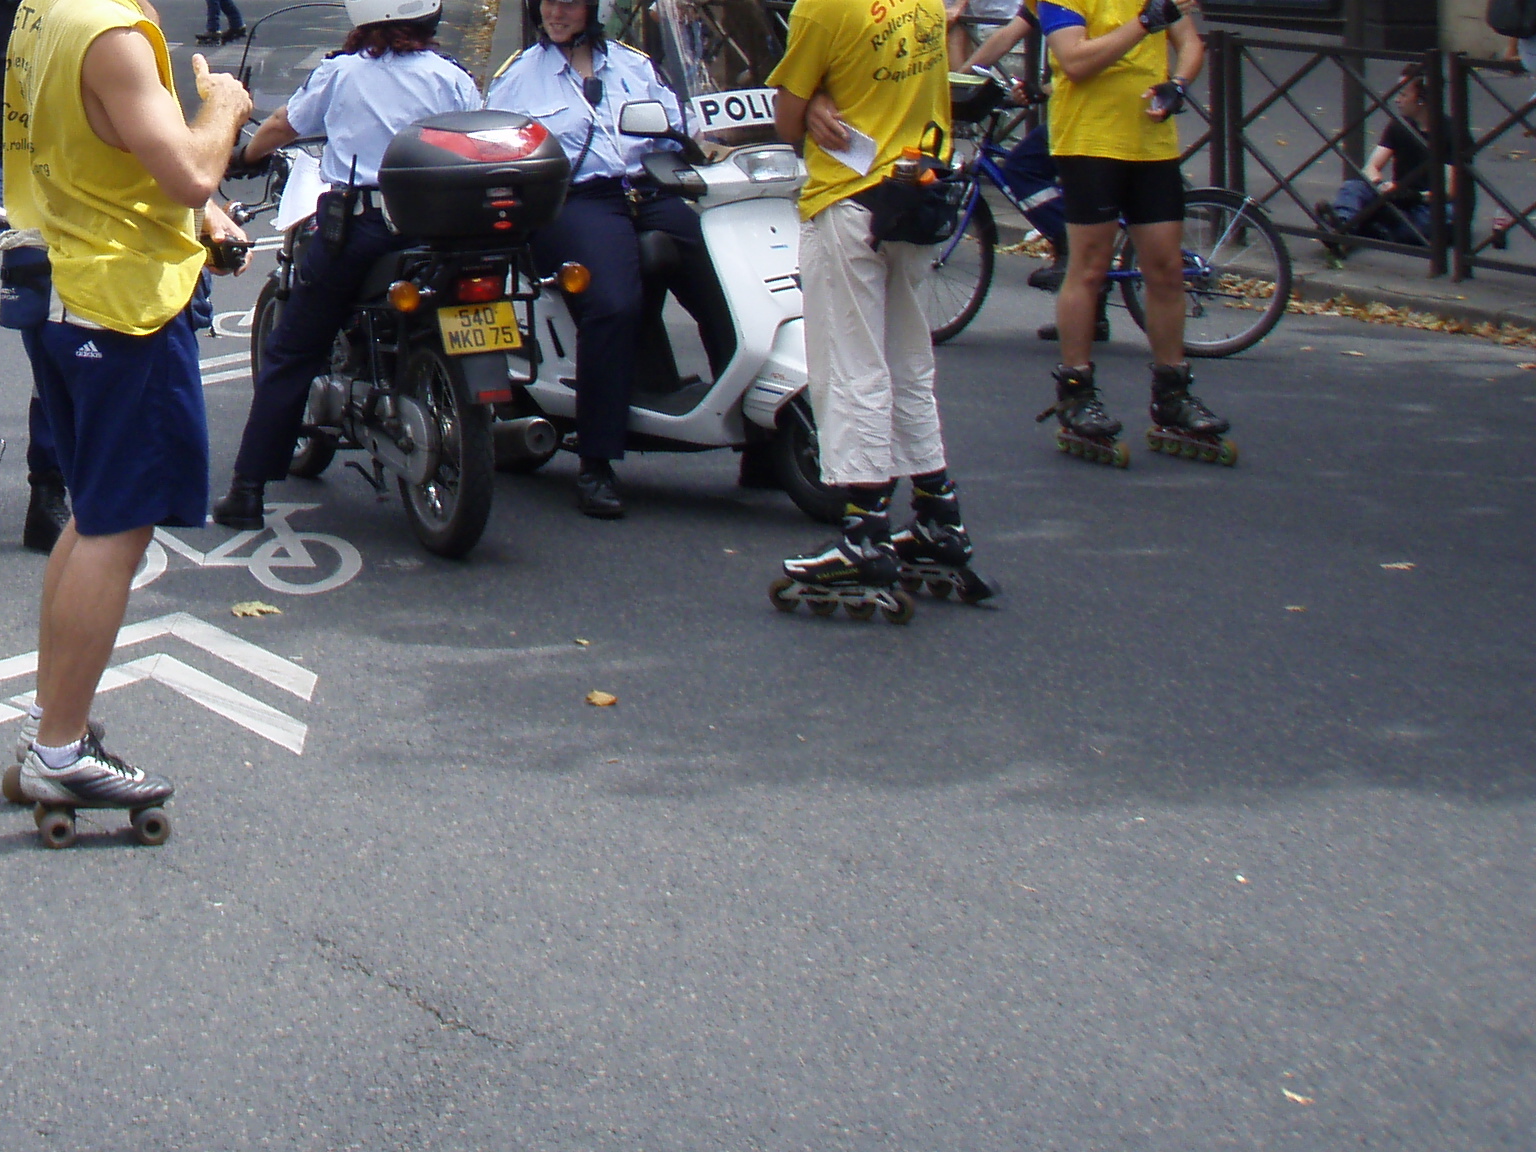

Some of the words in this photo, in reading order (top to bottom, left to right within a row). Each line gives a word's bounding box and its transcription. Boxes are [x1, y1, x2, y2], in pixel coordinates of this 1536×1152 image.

[870, 10, 914, 51] Rollers
[896, 37, 908, 58] &
[699, 93, 778, 126] POLI
[459, 307, 496, 327] 540
[448, 329, 486, 348] MKD
[488, 326, 514, 345] 75
[75, 350, 103, 359] adidas
